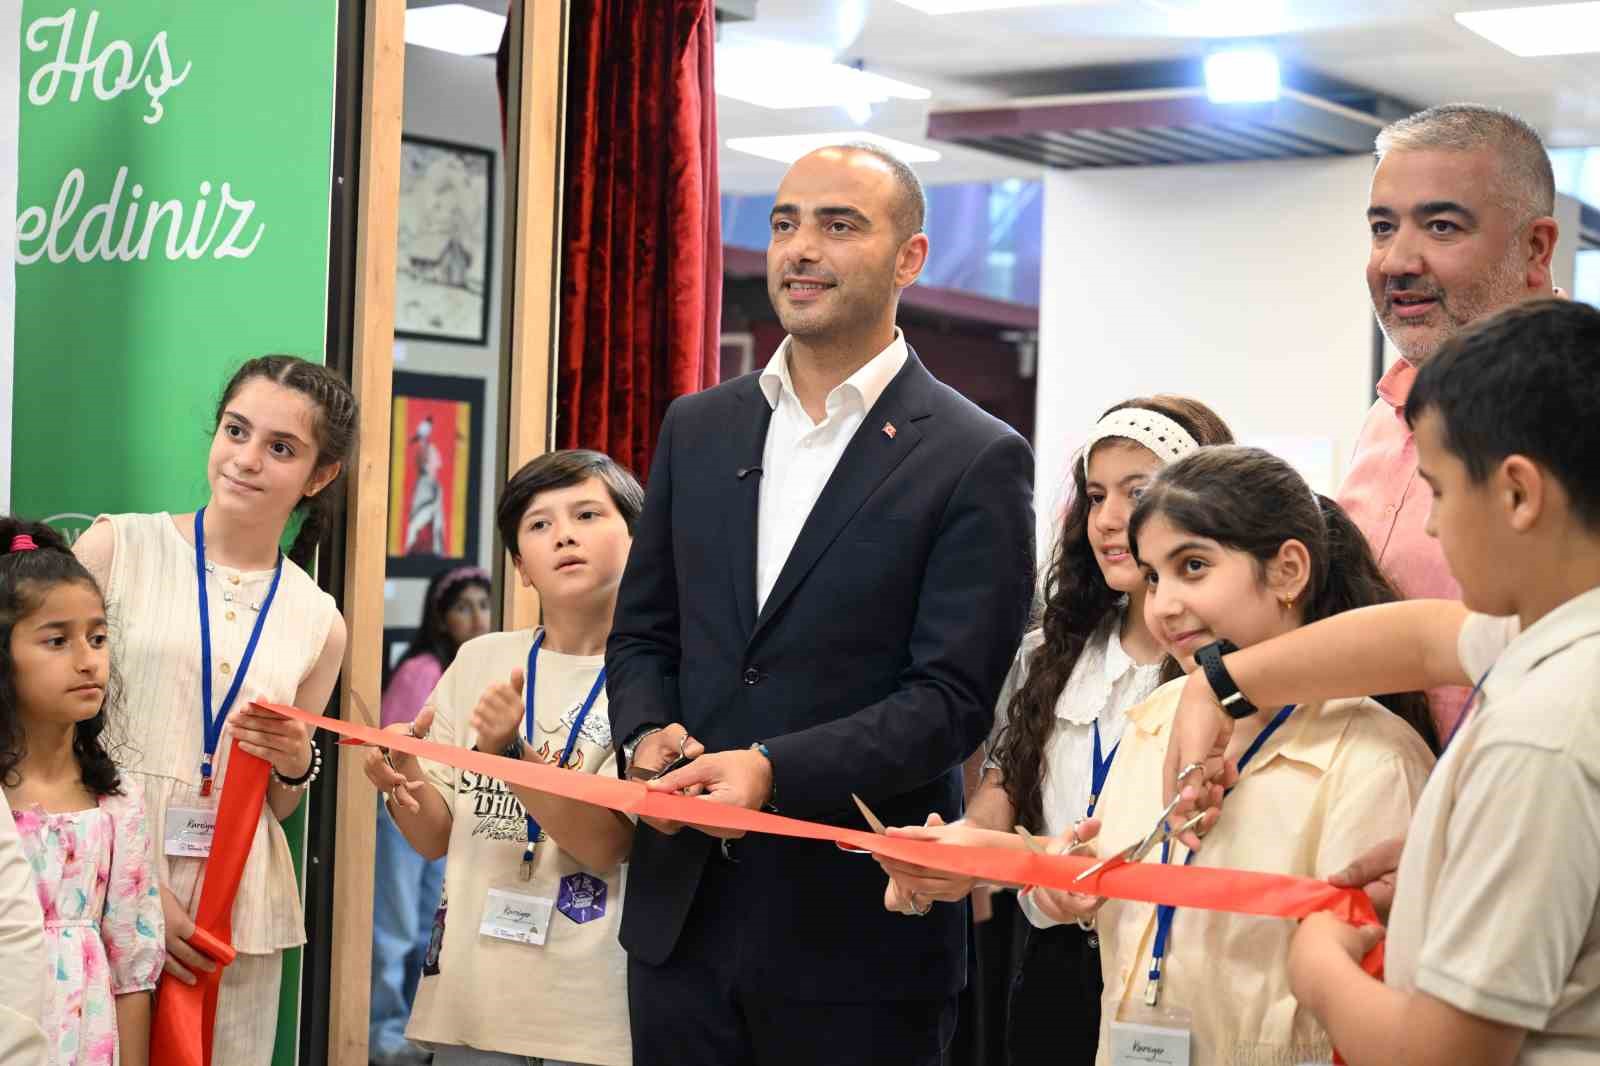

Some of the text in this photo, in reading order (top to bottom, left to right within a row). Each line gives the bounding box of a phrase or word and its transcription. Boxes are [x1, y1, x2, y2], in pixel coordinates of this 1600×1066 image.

[25, 7, 192, 125] Hoş
[15, 166, 265, 265] eldiniz
[474, 791, 529, 818] THIN
